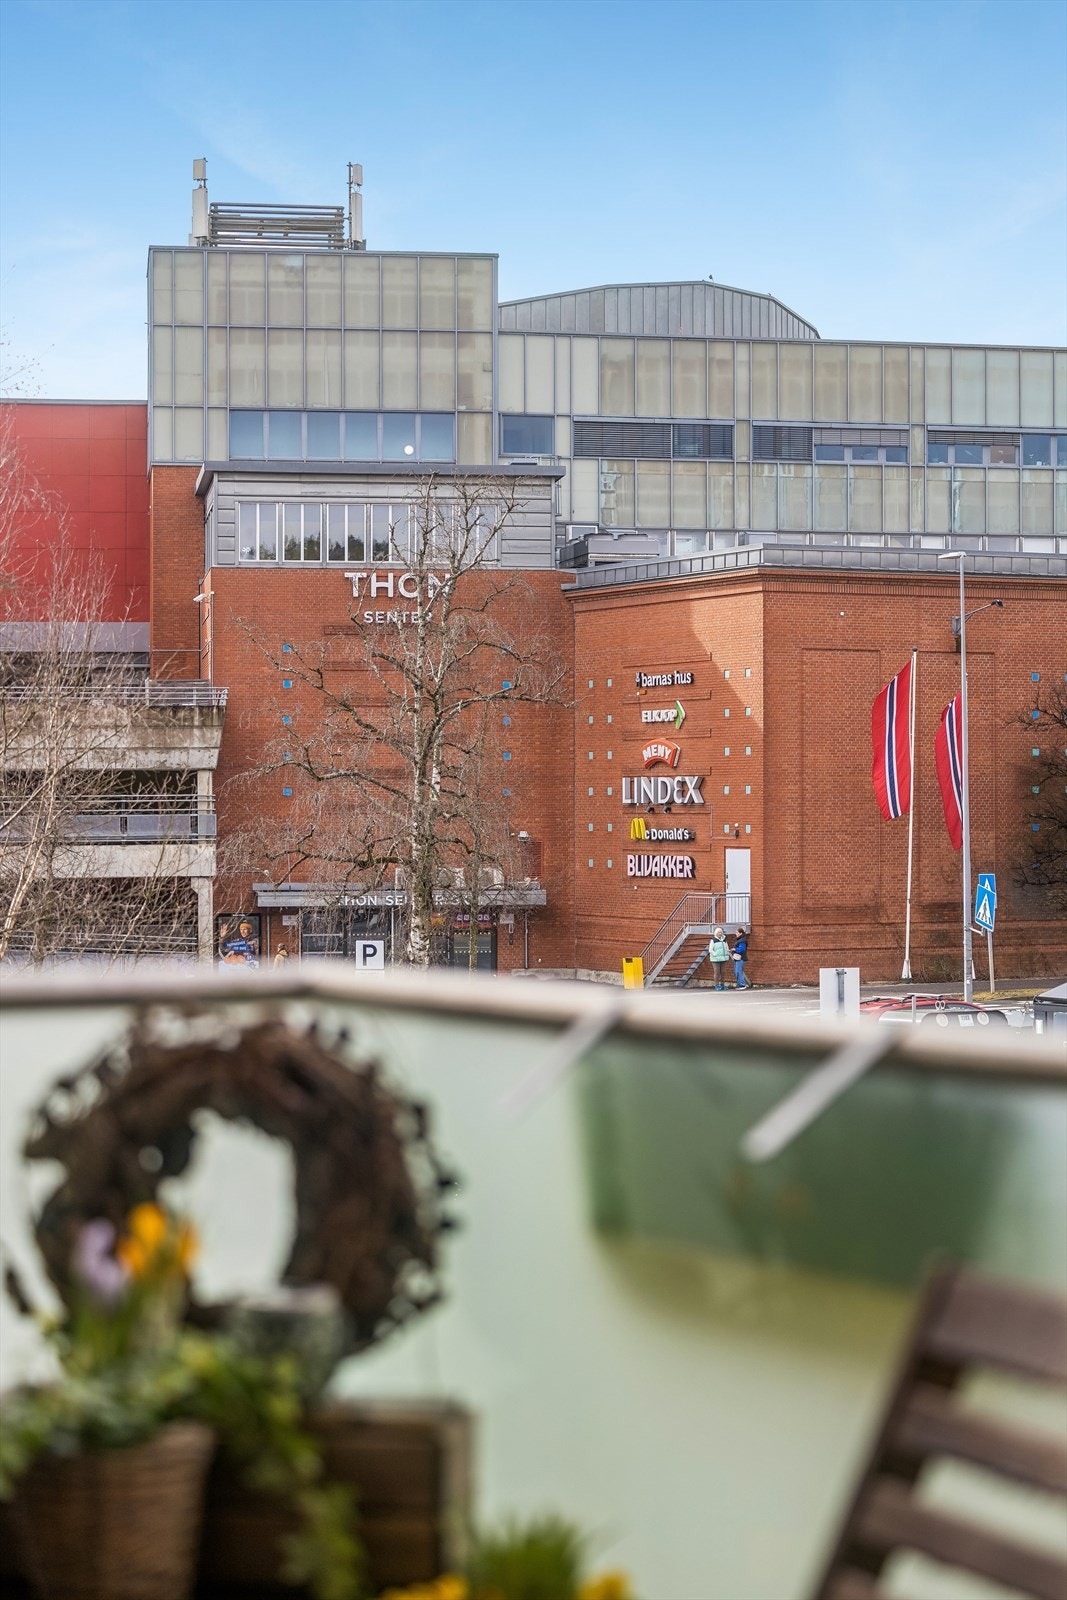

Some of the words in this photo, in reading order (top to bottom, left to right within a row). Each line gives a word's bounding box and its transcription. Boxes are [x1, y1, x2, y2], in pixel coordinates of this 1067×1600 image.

[344, 572, 451, 598] THON
[641, 672, 673, 687] barnas
[674, 670, 693, 685] hus
[642, 744, 672, 762] MENY
[622, 776, 705, 804] LINDEX
[630, 817, 691, 841] McDonald's
[627, 854, 694, 878] BLIVAKKER
[362, 944, 378, 966] P
